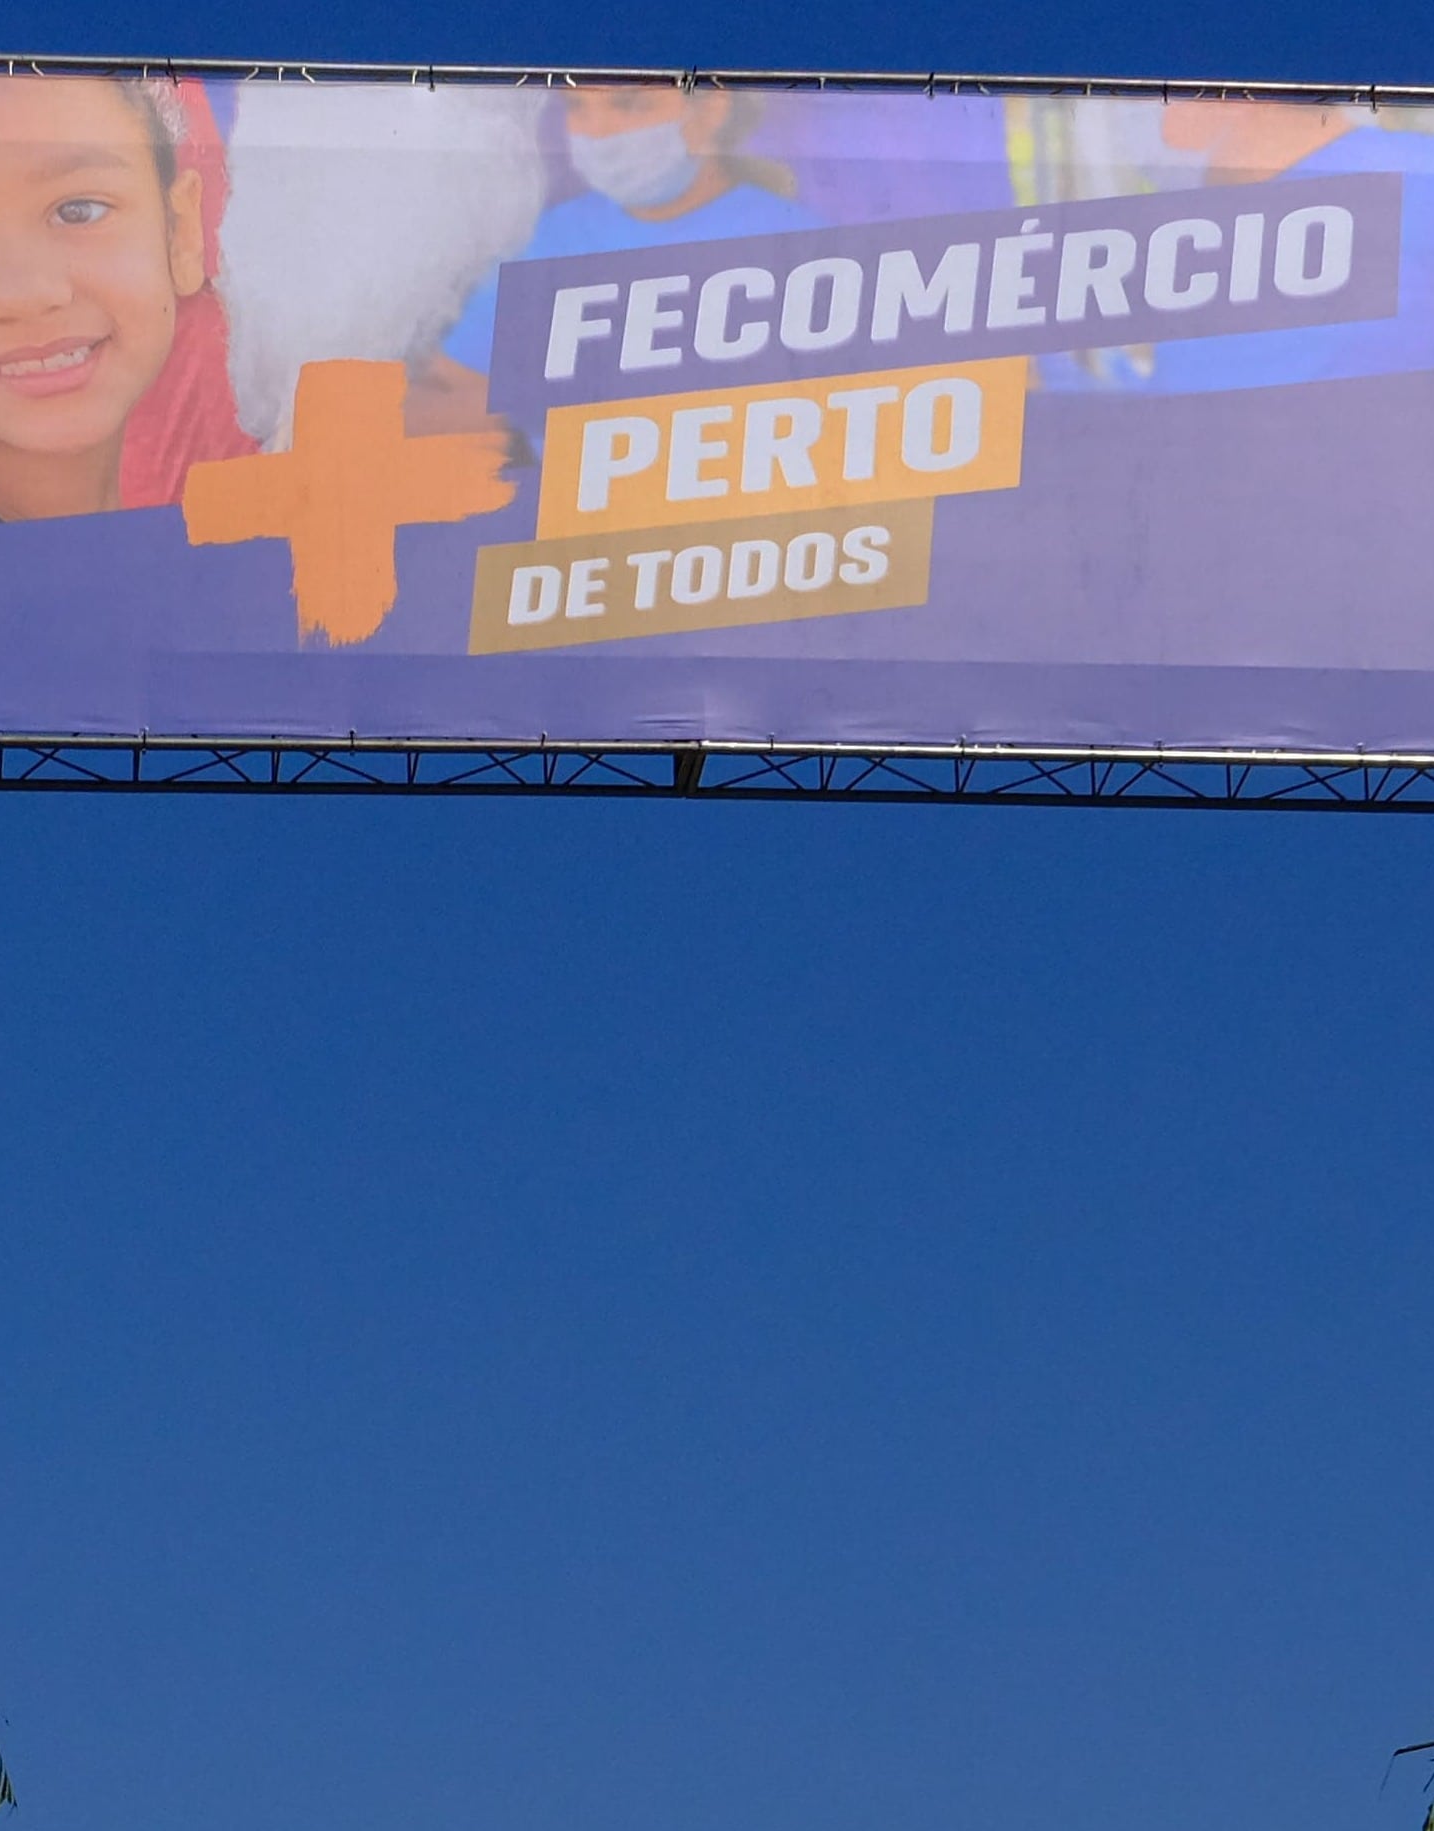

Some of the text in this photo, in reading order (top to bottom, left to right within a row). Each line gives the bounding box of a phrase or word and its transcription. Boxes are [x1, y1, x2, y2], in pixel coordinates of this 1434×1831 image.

[544, 205, 1354, 380] FECOMÉRCIO
[576, 377, 983, 512] PERTO
[508, 525, 892, 625] DE TODOS
